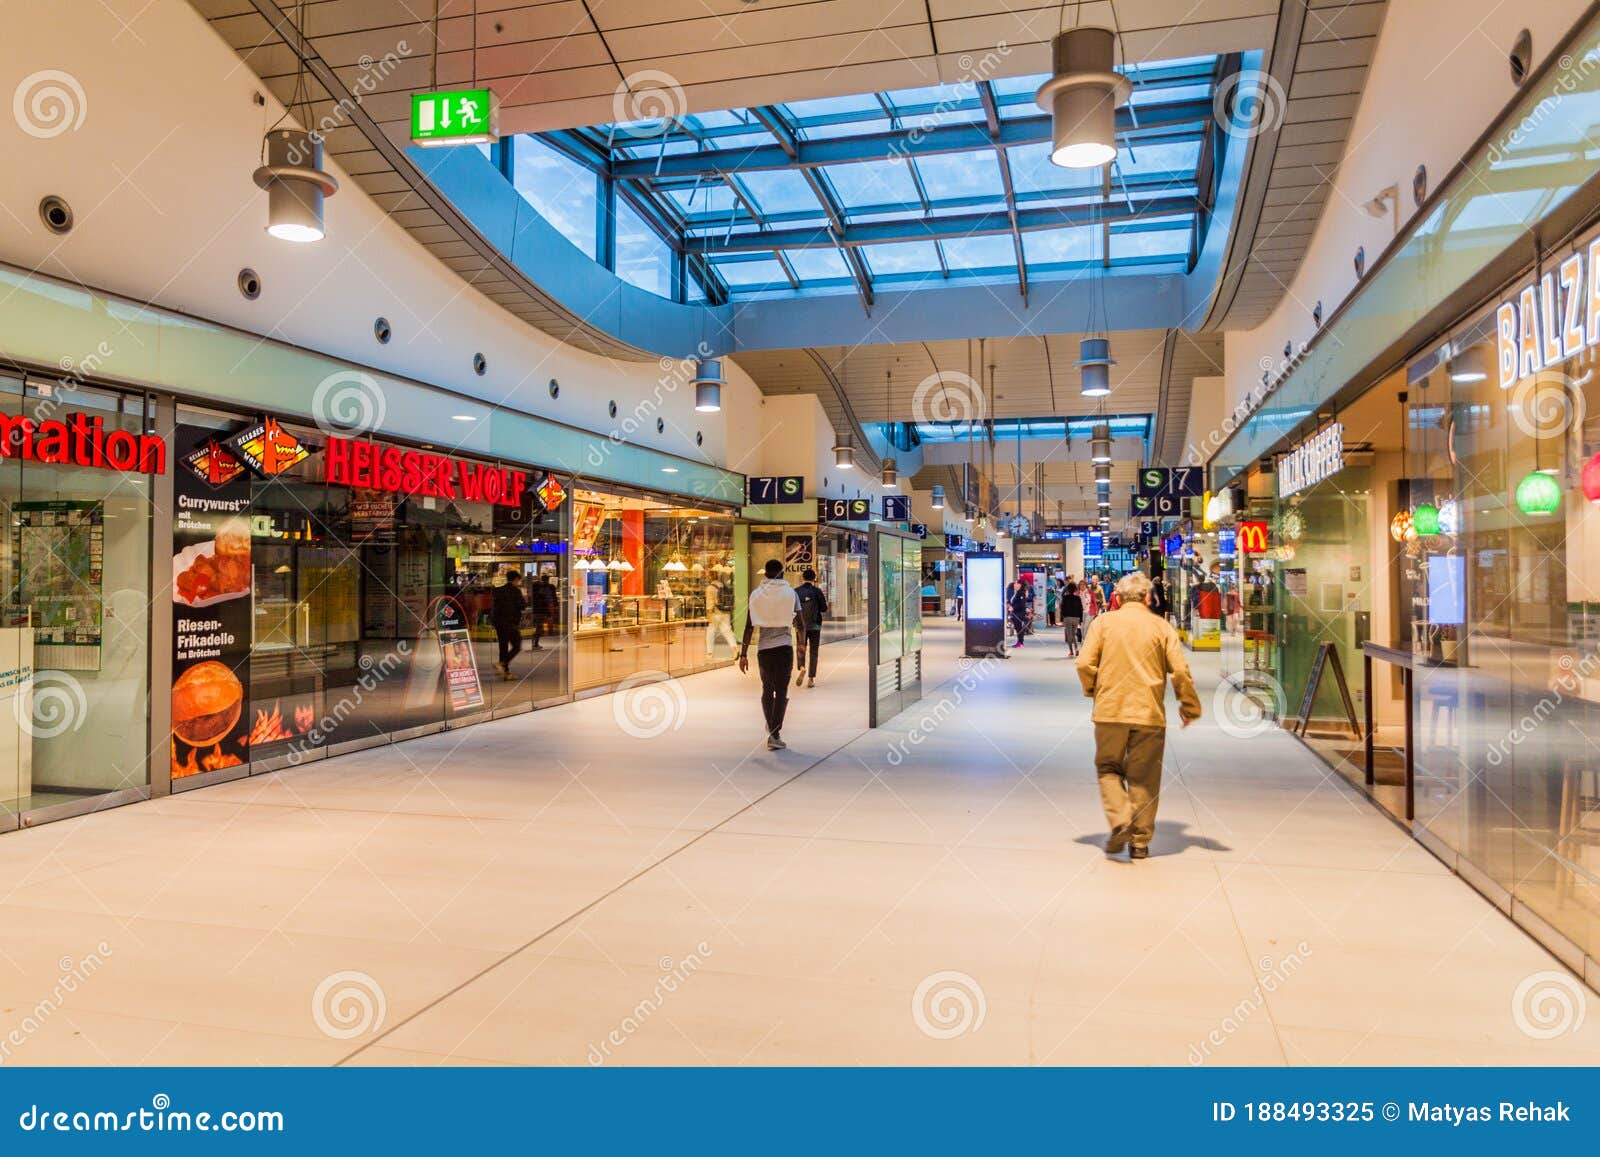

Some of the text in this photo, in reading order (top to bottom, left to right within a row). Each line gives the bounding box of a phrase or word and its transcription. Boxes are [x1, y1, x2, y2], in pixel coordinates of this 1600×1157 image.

[0, 411, 165, 475] mation
[237, 426, 265, 446] HEISSER
[188, 447, 210, 462] HEISSER
[243, 452, 262, 470] WOLF
[193, 466, 208, 480] WOLF
[325, 435, 526, 507] HEISSER WOLF
[1144, 468, 1191, 489] S 7
[759, 478, 799, 499] 7 S
[178, 495, 241, 512] Currywurst
[833, 500, 865, 516] 6 S
[1159, 497, 1171, 512] 6
[178, 511, 191, 519] mit
[917, 524, 925, 536] 3
[1143, 521, 1152, 534] 3
[177, 618, 222, 633] Riesen-
[177, 632, 235, 649] Frikadelle
[188, 648, 221, 659] Brötchen
